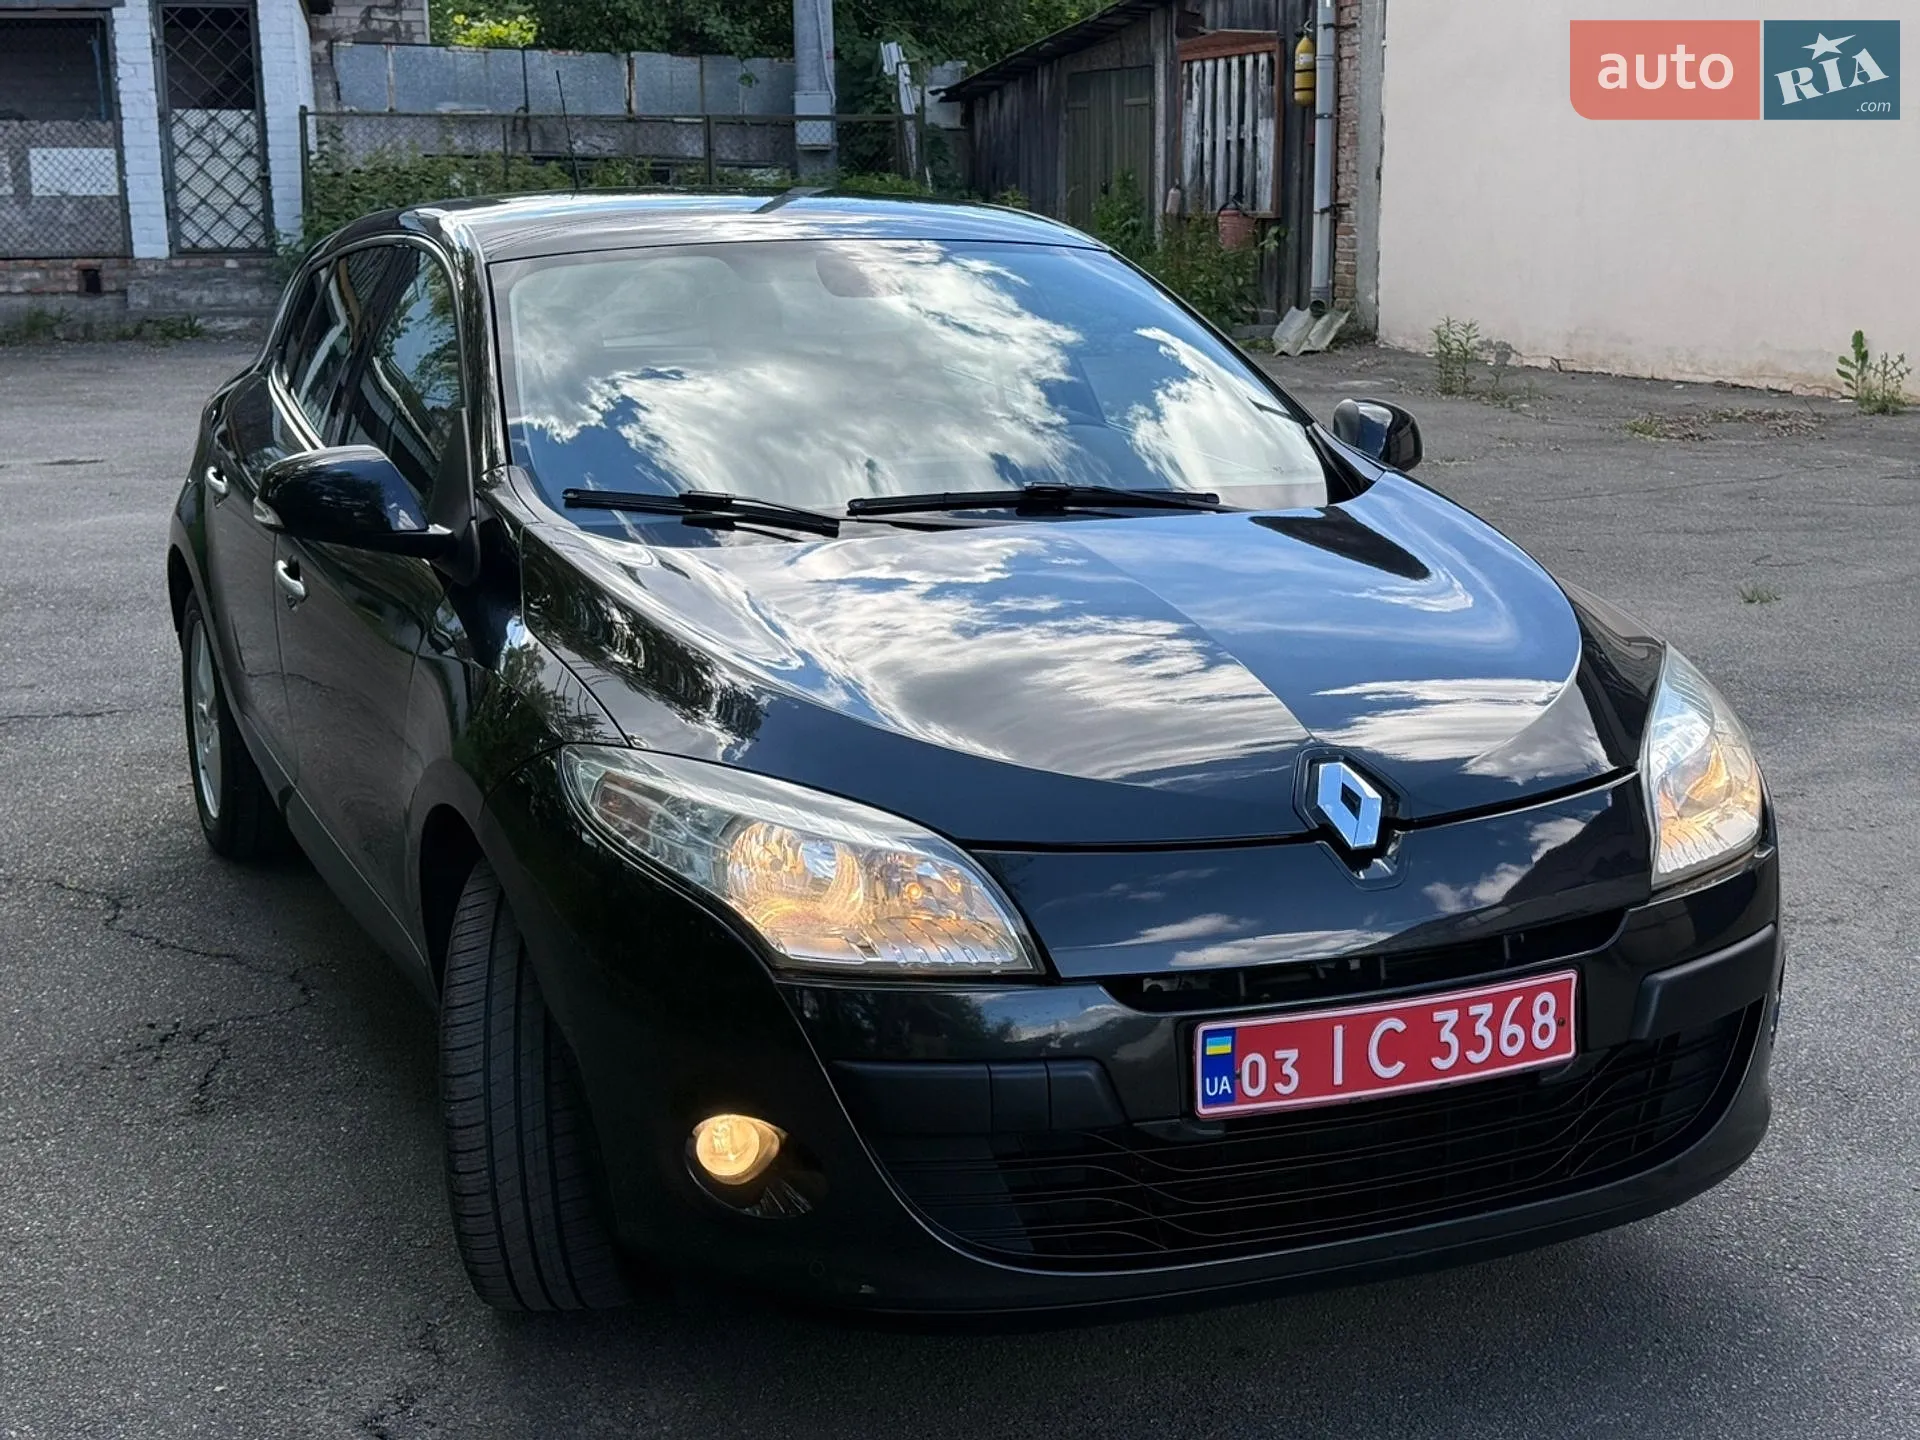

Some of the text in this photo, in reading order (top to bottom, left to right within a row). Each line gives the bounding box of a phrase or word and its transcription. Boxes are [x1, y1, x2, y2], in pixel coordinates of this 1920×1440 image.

[1241, 991, 1557, 1097] 03 IC 3368
[1205, 1074, 1232, 1097] UA
